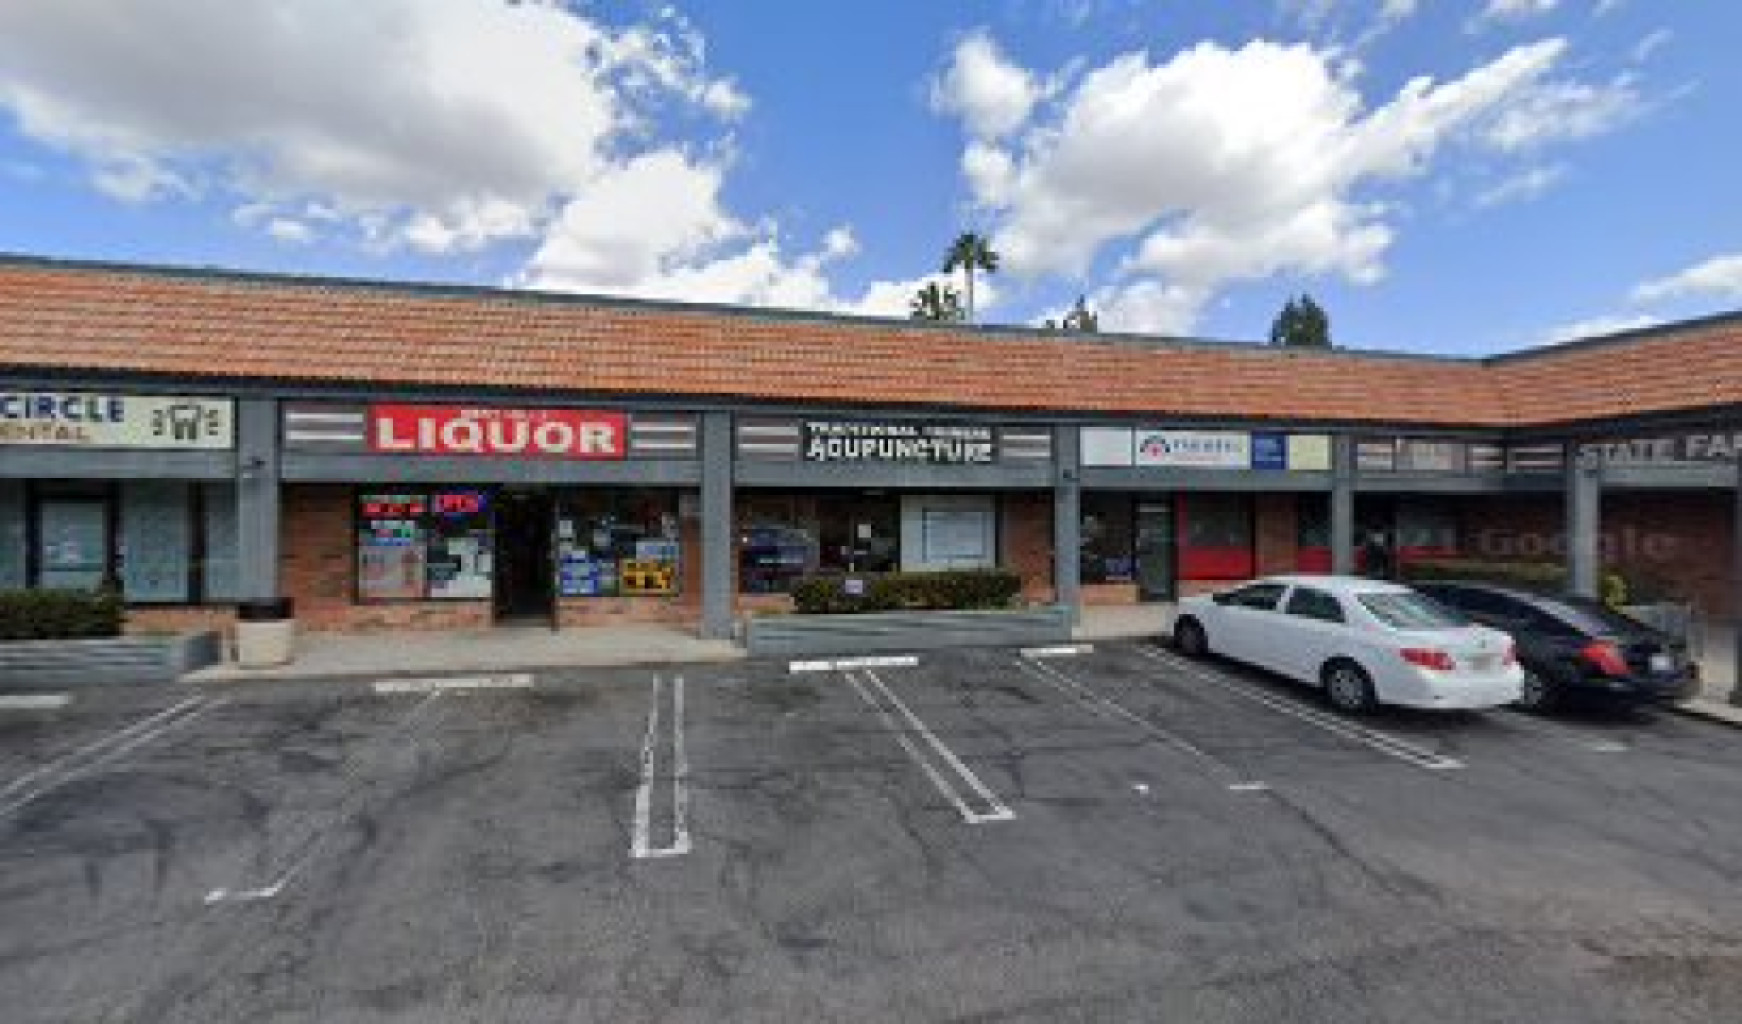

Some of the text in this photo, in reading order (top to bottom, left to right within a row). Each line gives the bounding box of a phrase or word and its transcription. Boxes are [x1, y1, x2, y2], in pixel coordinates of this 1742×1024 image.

[0, 396, 125, 423] CIRCLE
[376, 417, 615, 453] LIQUOR
[806, 439, 990, 461] ACUPUNCTURE
[1575, 438, 1675, 468] STATE
